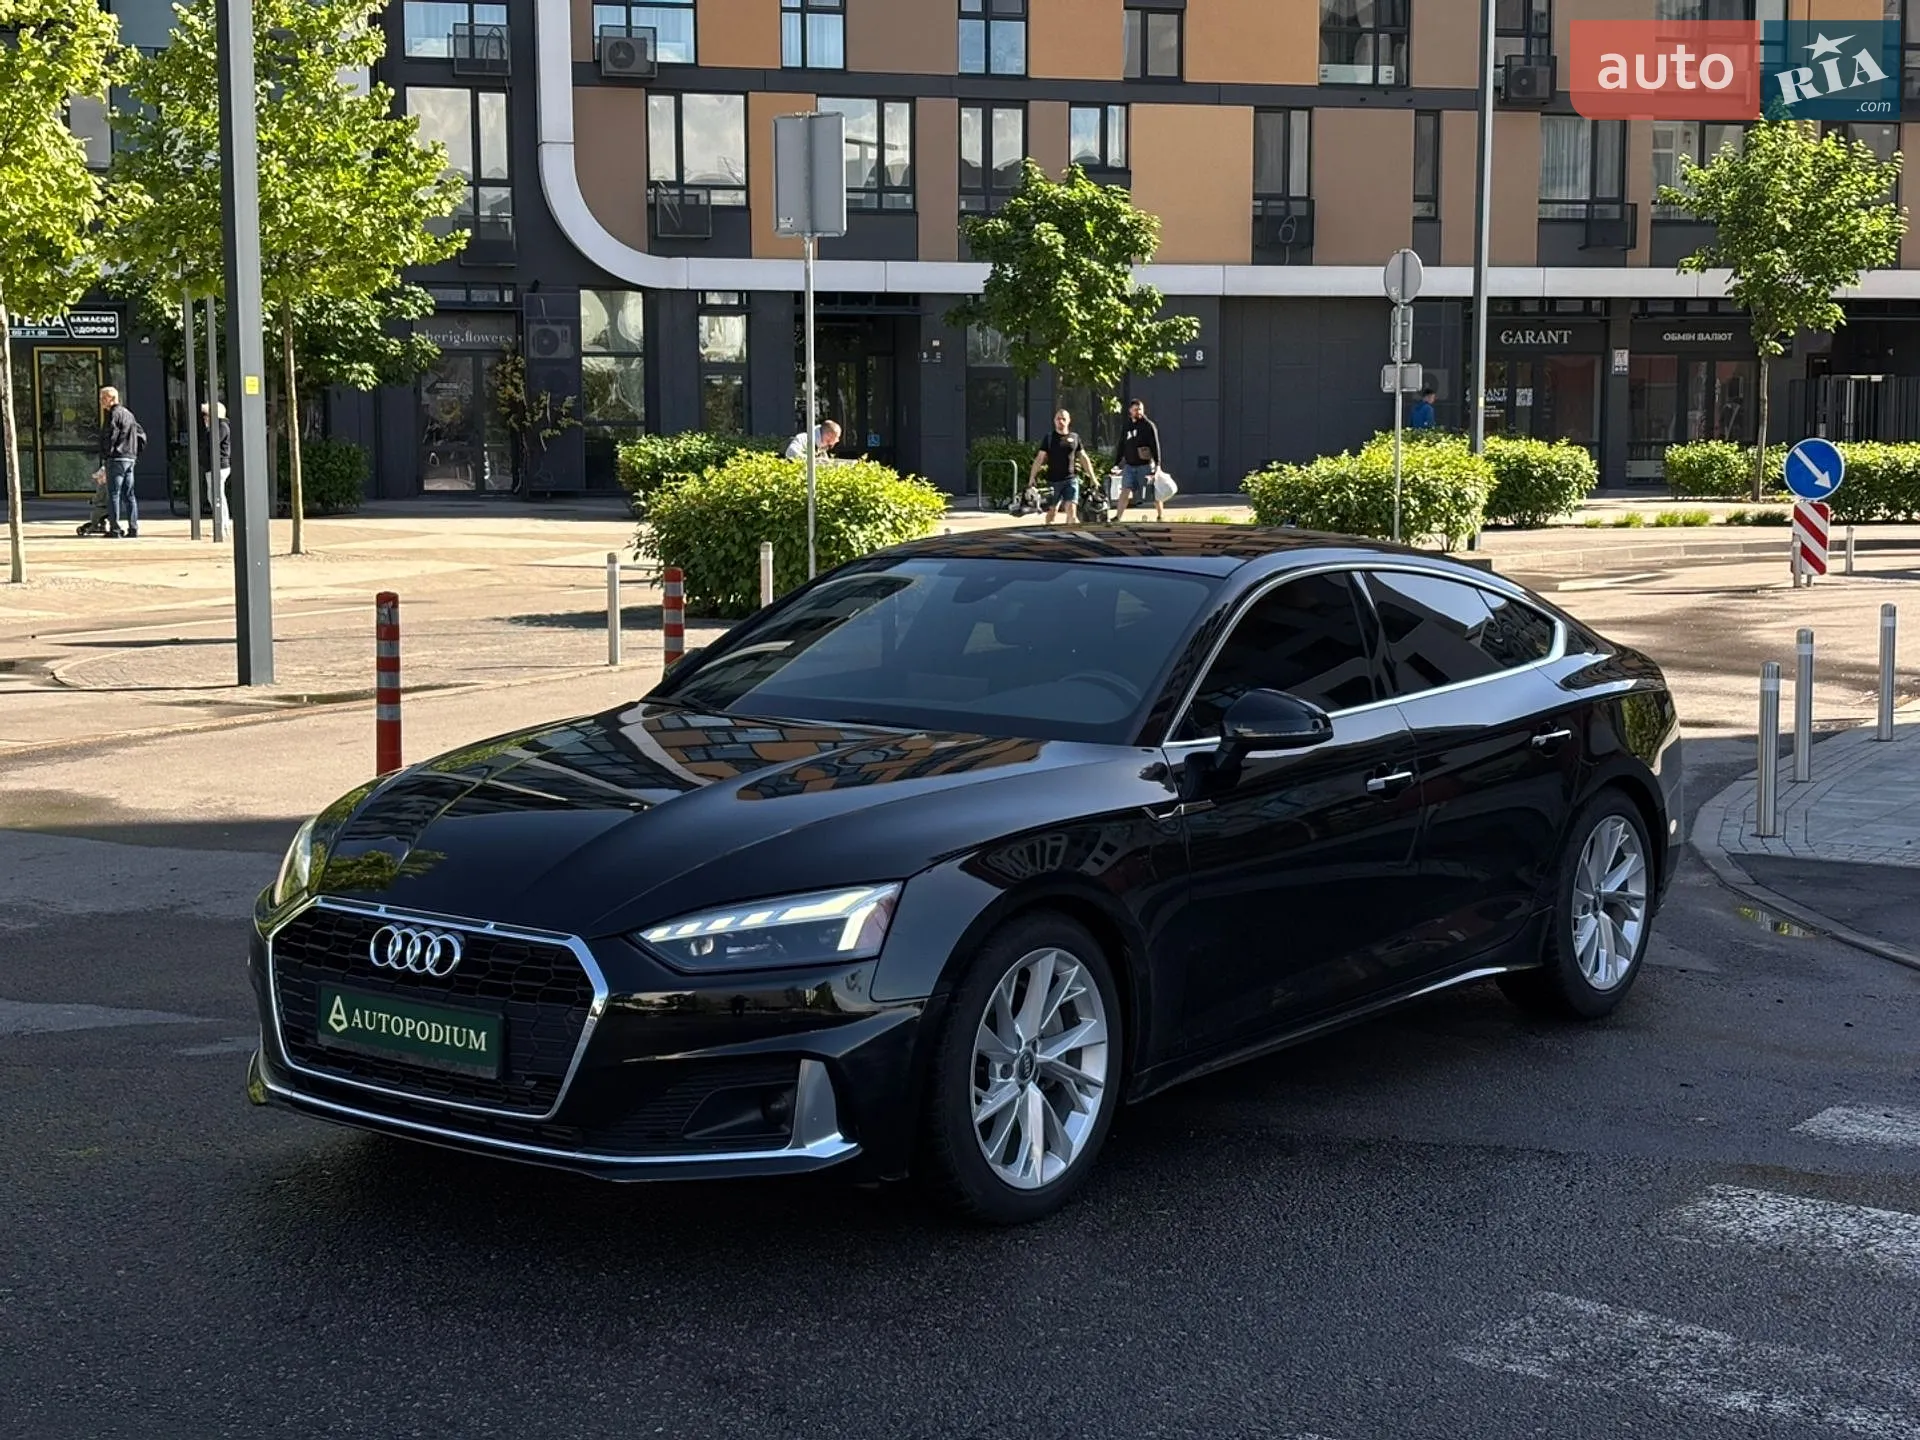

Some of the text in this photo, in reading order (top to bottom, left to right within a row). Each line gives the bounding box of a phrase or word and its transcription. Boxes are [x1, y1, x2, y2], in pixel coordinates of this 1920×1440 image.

[9, 312, 65, 327] ТЕКА
[1500, 330, 1572, 344] GARANT
[1697, 332, 1733, 341] ВАЛЮТ
[1195, 350, 1204, 361] 8
[351, 1008, 487, 1051] AUTOPODIUM
